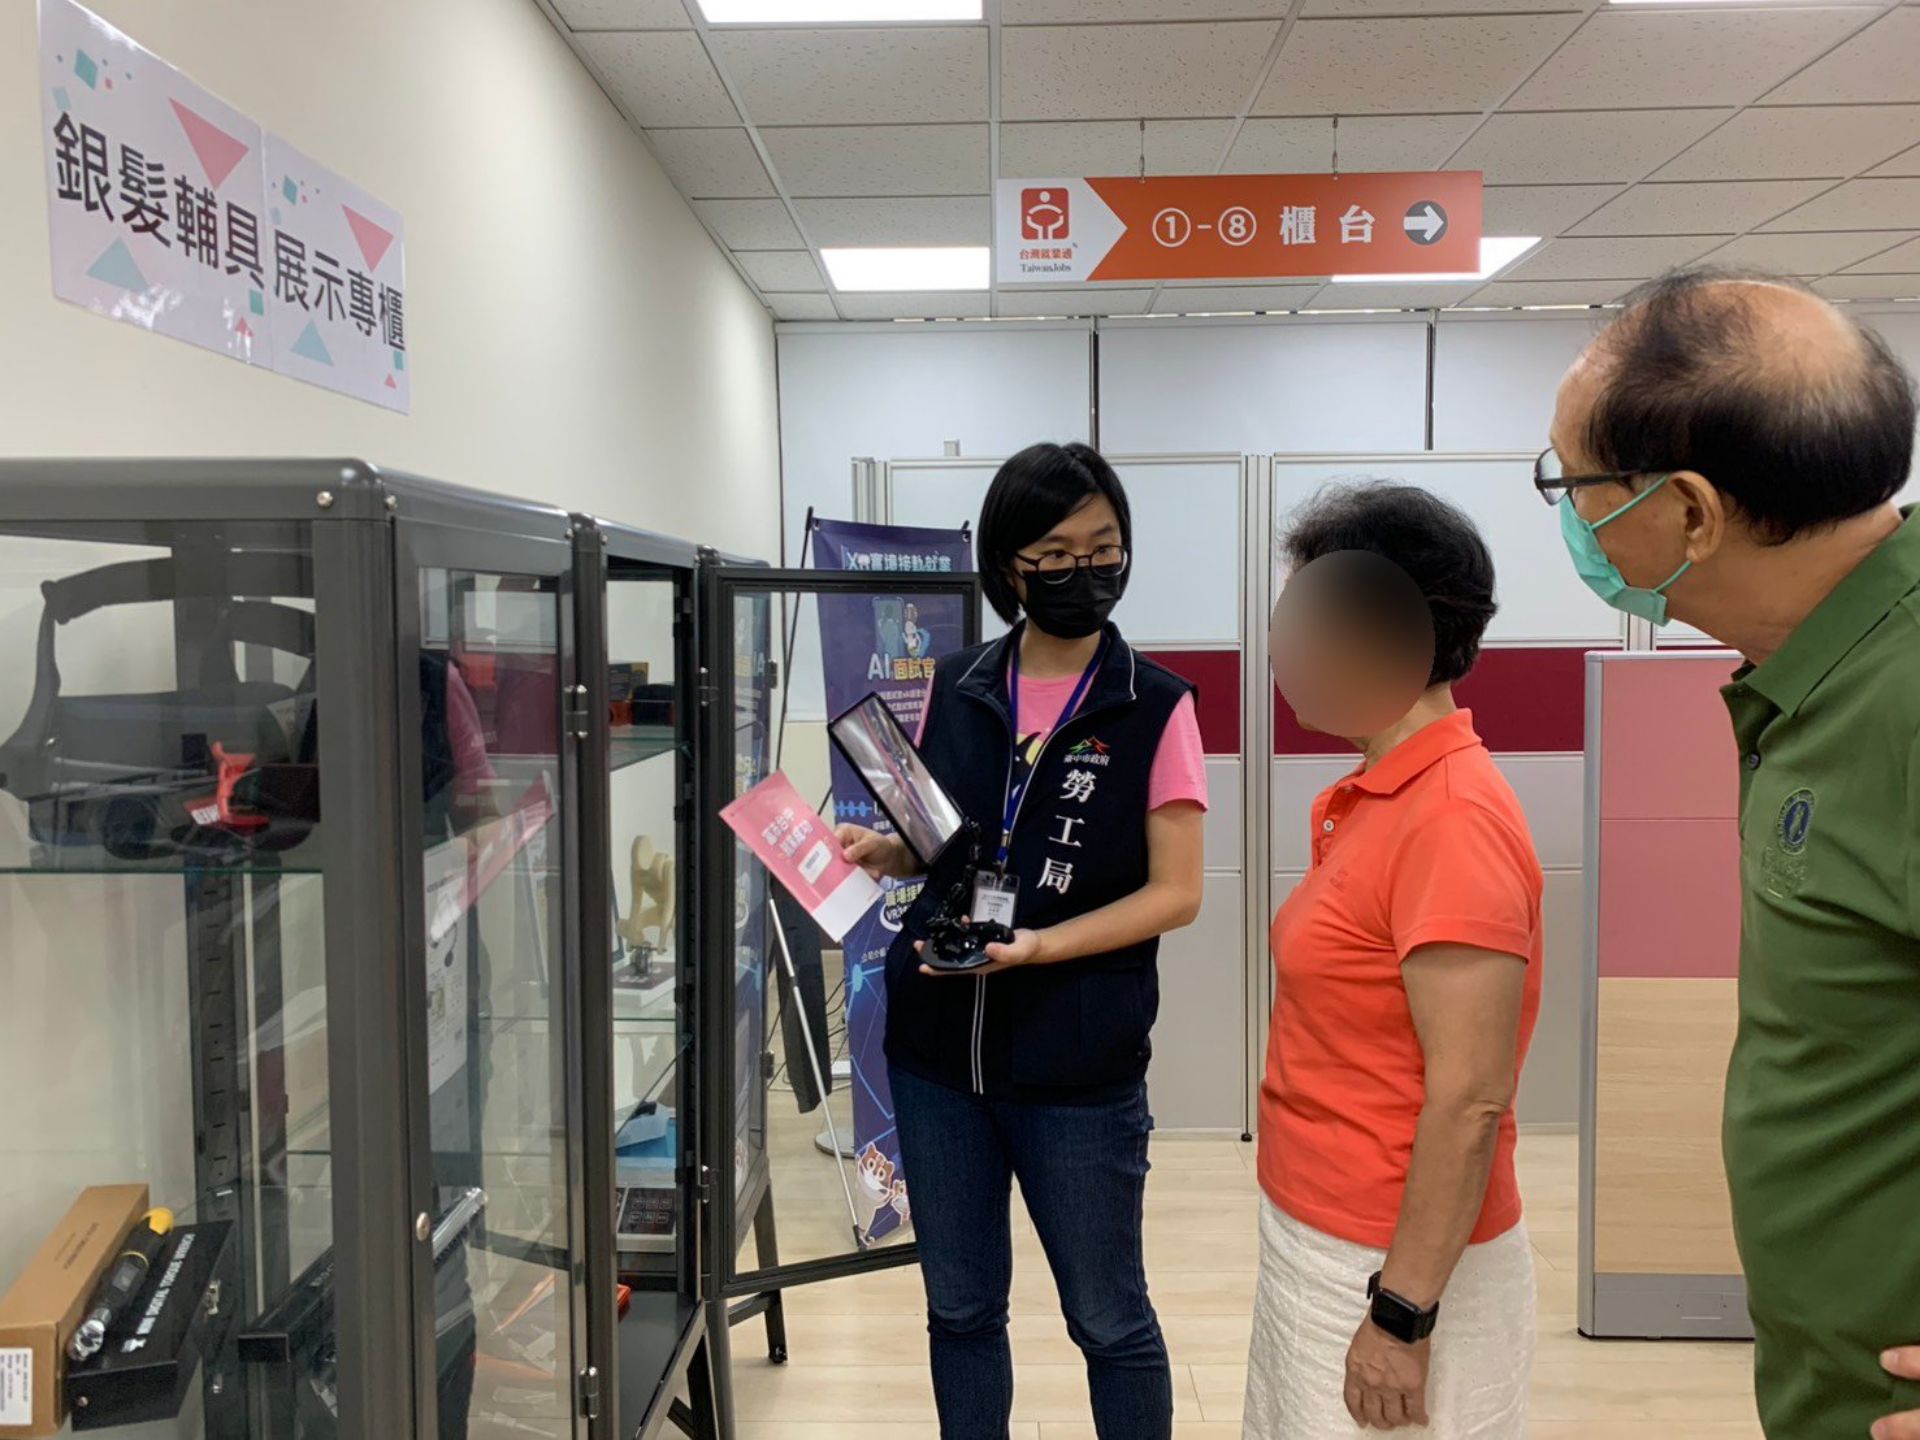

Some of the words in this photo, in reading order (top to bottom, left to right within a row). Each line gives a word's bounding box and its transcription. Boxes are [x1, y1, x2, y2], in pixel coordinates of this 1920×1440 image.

[53, 111, 405, 351] 銀髮輔具展示專櫃
[1279, 204, 1376, 245] 櫃台
[1019, 247, 1073, 260] 台灣就業通
[1020, 262, 1072, 273] TaiwanJobs
[1036, 768, 1097, 895] 勞工局
